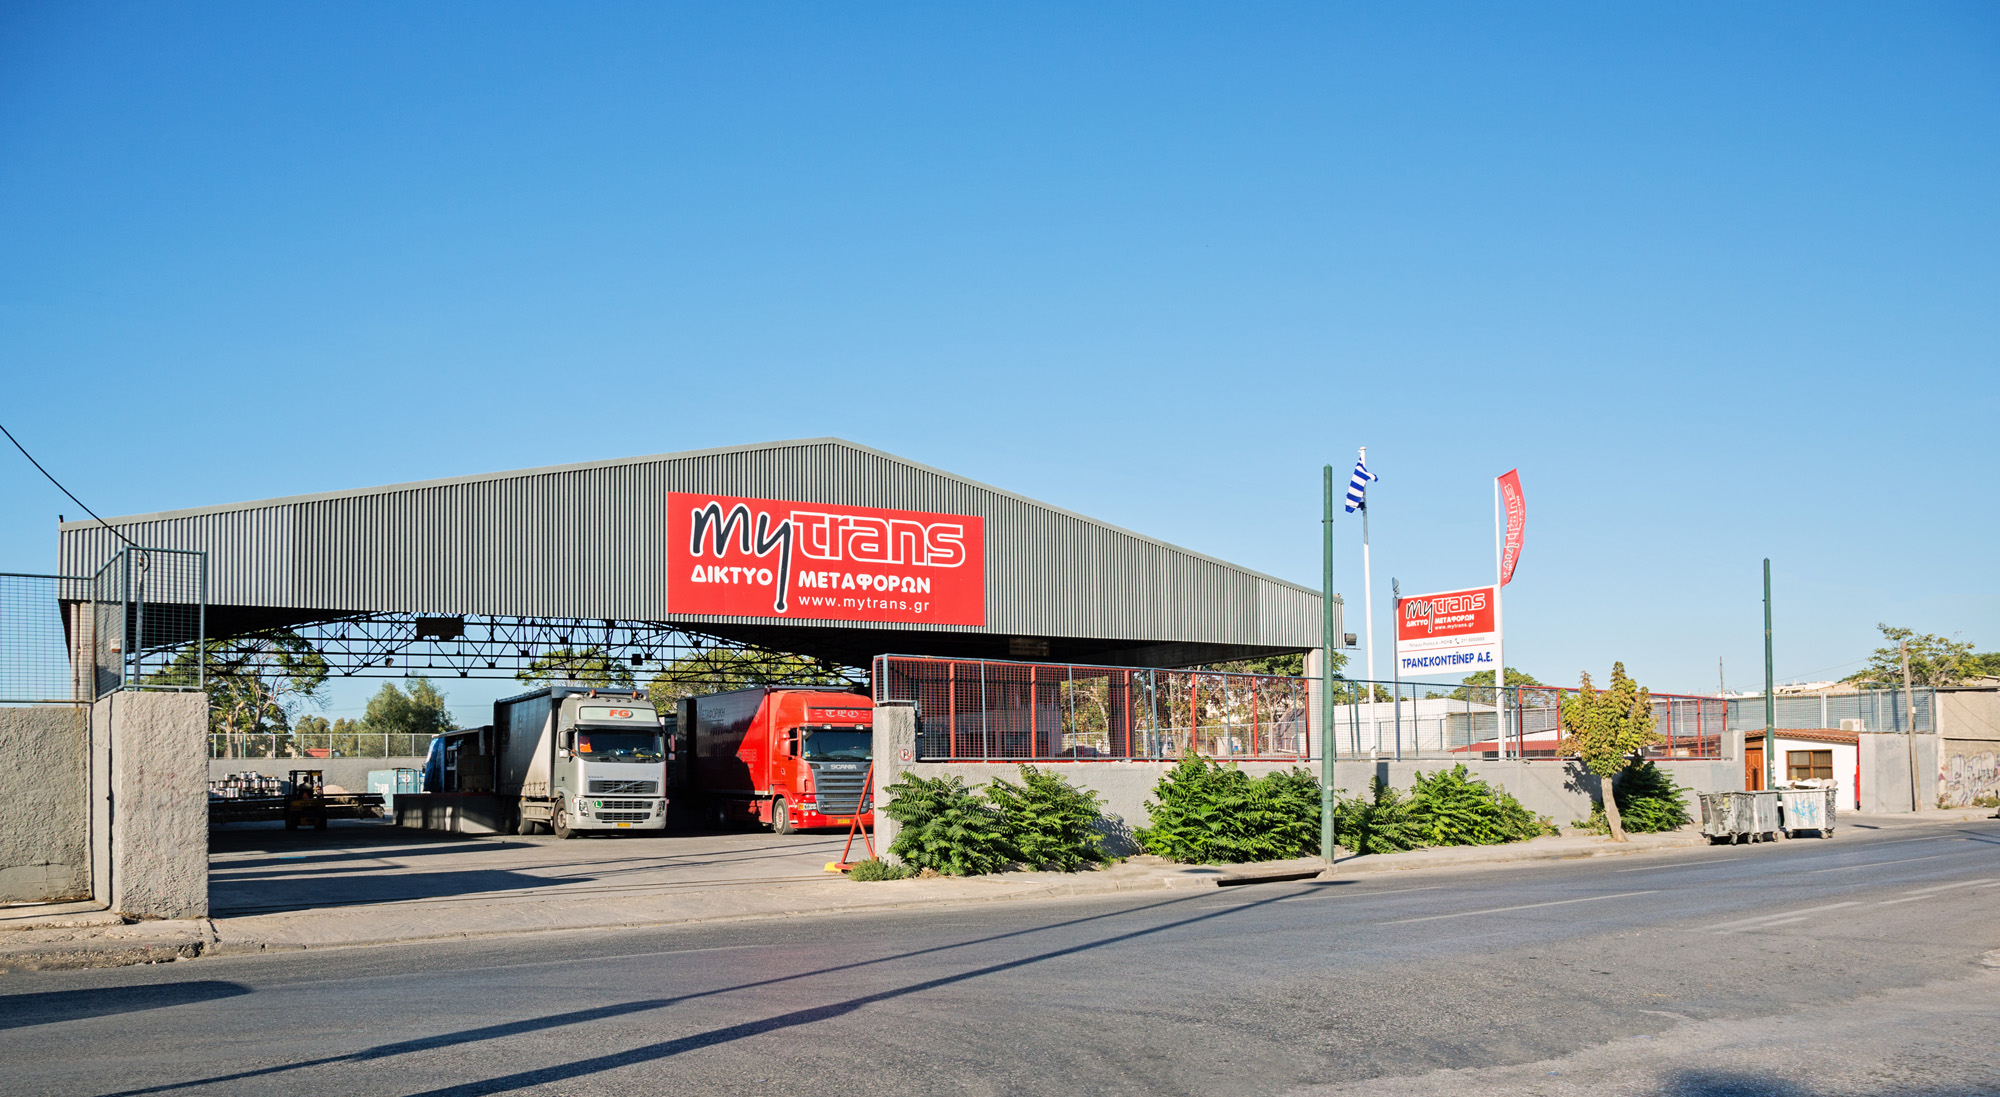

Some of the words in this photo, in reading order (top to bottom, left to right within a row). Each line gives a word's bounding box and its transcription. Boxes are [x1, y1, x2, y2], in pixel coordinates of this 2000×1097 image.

[690, 501, 966, 613] mytrans
[691, 564, 773, 586] ΔΙΚΤΥΟ
[798, 571, 931, 594] ΜΕΤΑΦΟΡΩΝ
[798, 595, 930, 613] www.mytrans.gr
[1406, 593, 1485, 633] mytrans
[1406, 618, 1428, 627] ΔΙΚΤΥΟ
[1434, 614, 1474, 625] ΜΕΤΑΦΟΡΩΝ
[1434, 622, 1474, 631] www.mytrans.gr
[1402, 651, 1474, 669] ΤΡΑΝΣΚΟΝΤΕΪΝΕΡ
[1477, 651, 1493, 663] Α.Ε.
[609, 709, 629, 718] FG
